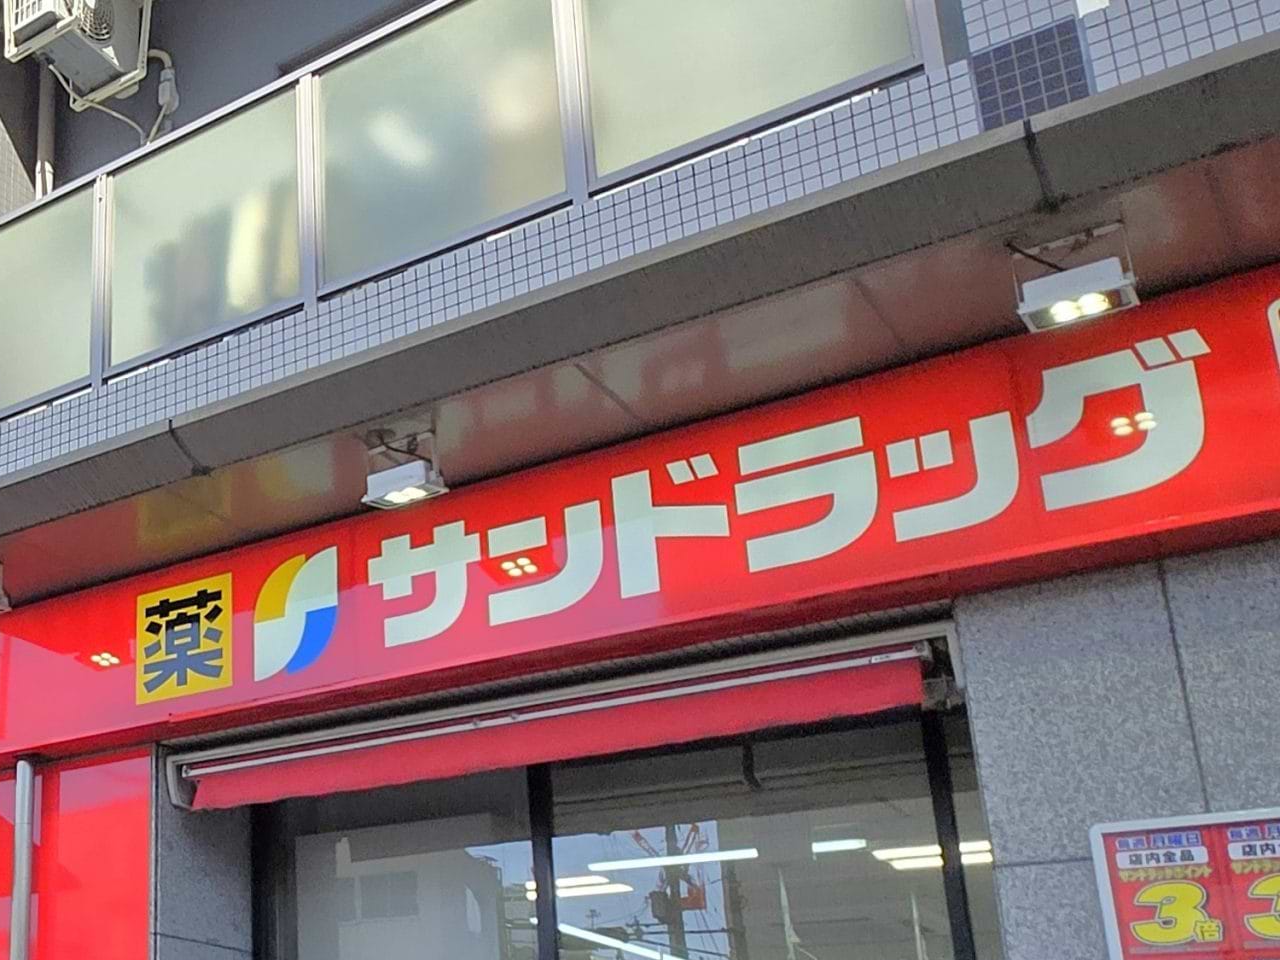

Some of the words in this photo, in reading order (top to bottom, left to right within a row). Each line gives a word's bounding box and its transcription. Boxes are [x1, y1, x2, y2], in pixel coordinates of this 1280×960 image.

[367, 328, 1212, 648] サンドラッグ
[143, 588, 225, 692] 薬
